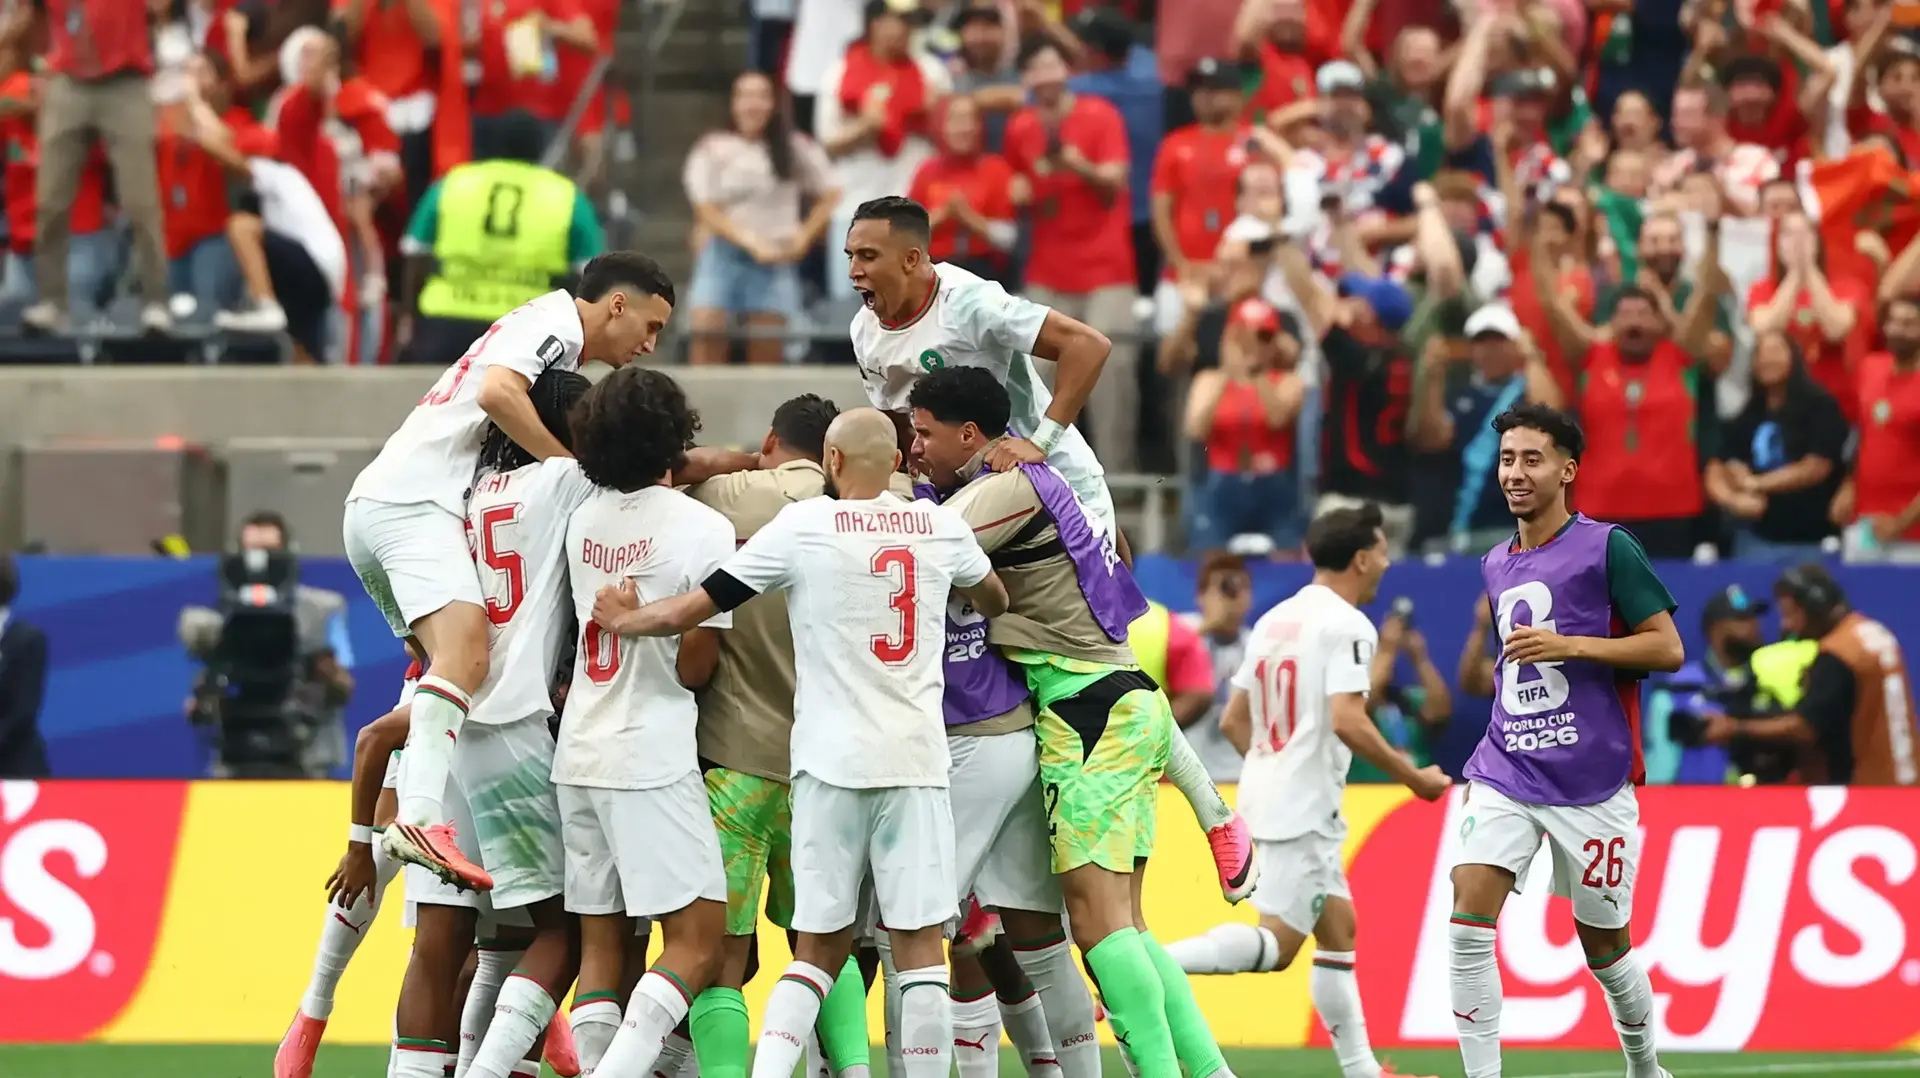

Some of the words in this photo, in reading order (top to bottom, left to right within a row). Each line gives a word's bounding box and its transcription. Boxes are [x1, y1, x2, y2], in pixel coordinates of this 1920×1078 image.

[834, 511, 933, 535] MAZRAOUI
[464, 502, 527, 629] 5
[870, 545, 919, 667] 3
[947, 640, 988, 663] 20
[1254, 657, 1299, 754] 10
[1517, 685, 1550, 704] FIFA
[1503, 717, 1546, 732] WORLD
[1548, 712, 1576, 727] CUP
[1504, 726, 1579, 752] 2026
[1581, 836, 1625, 888] 26
